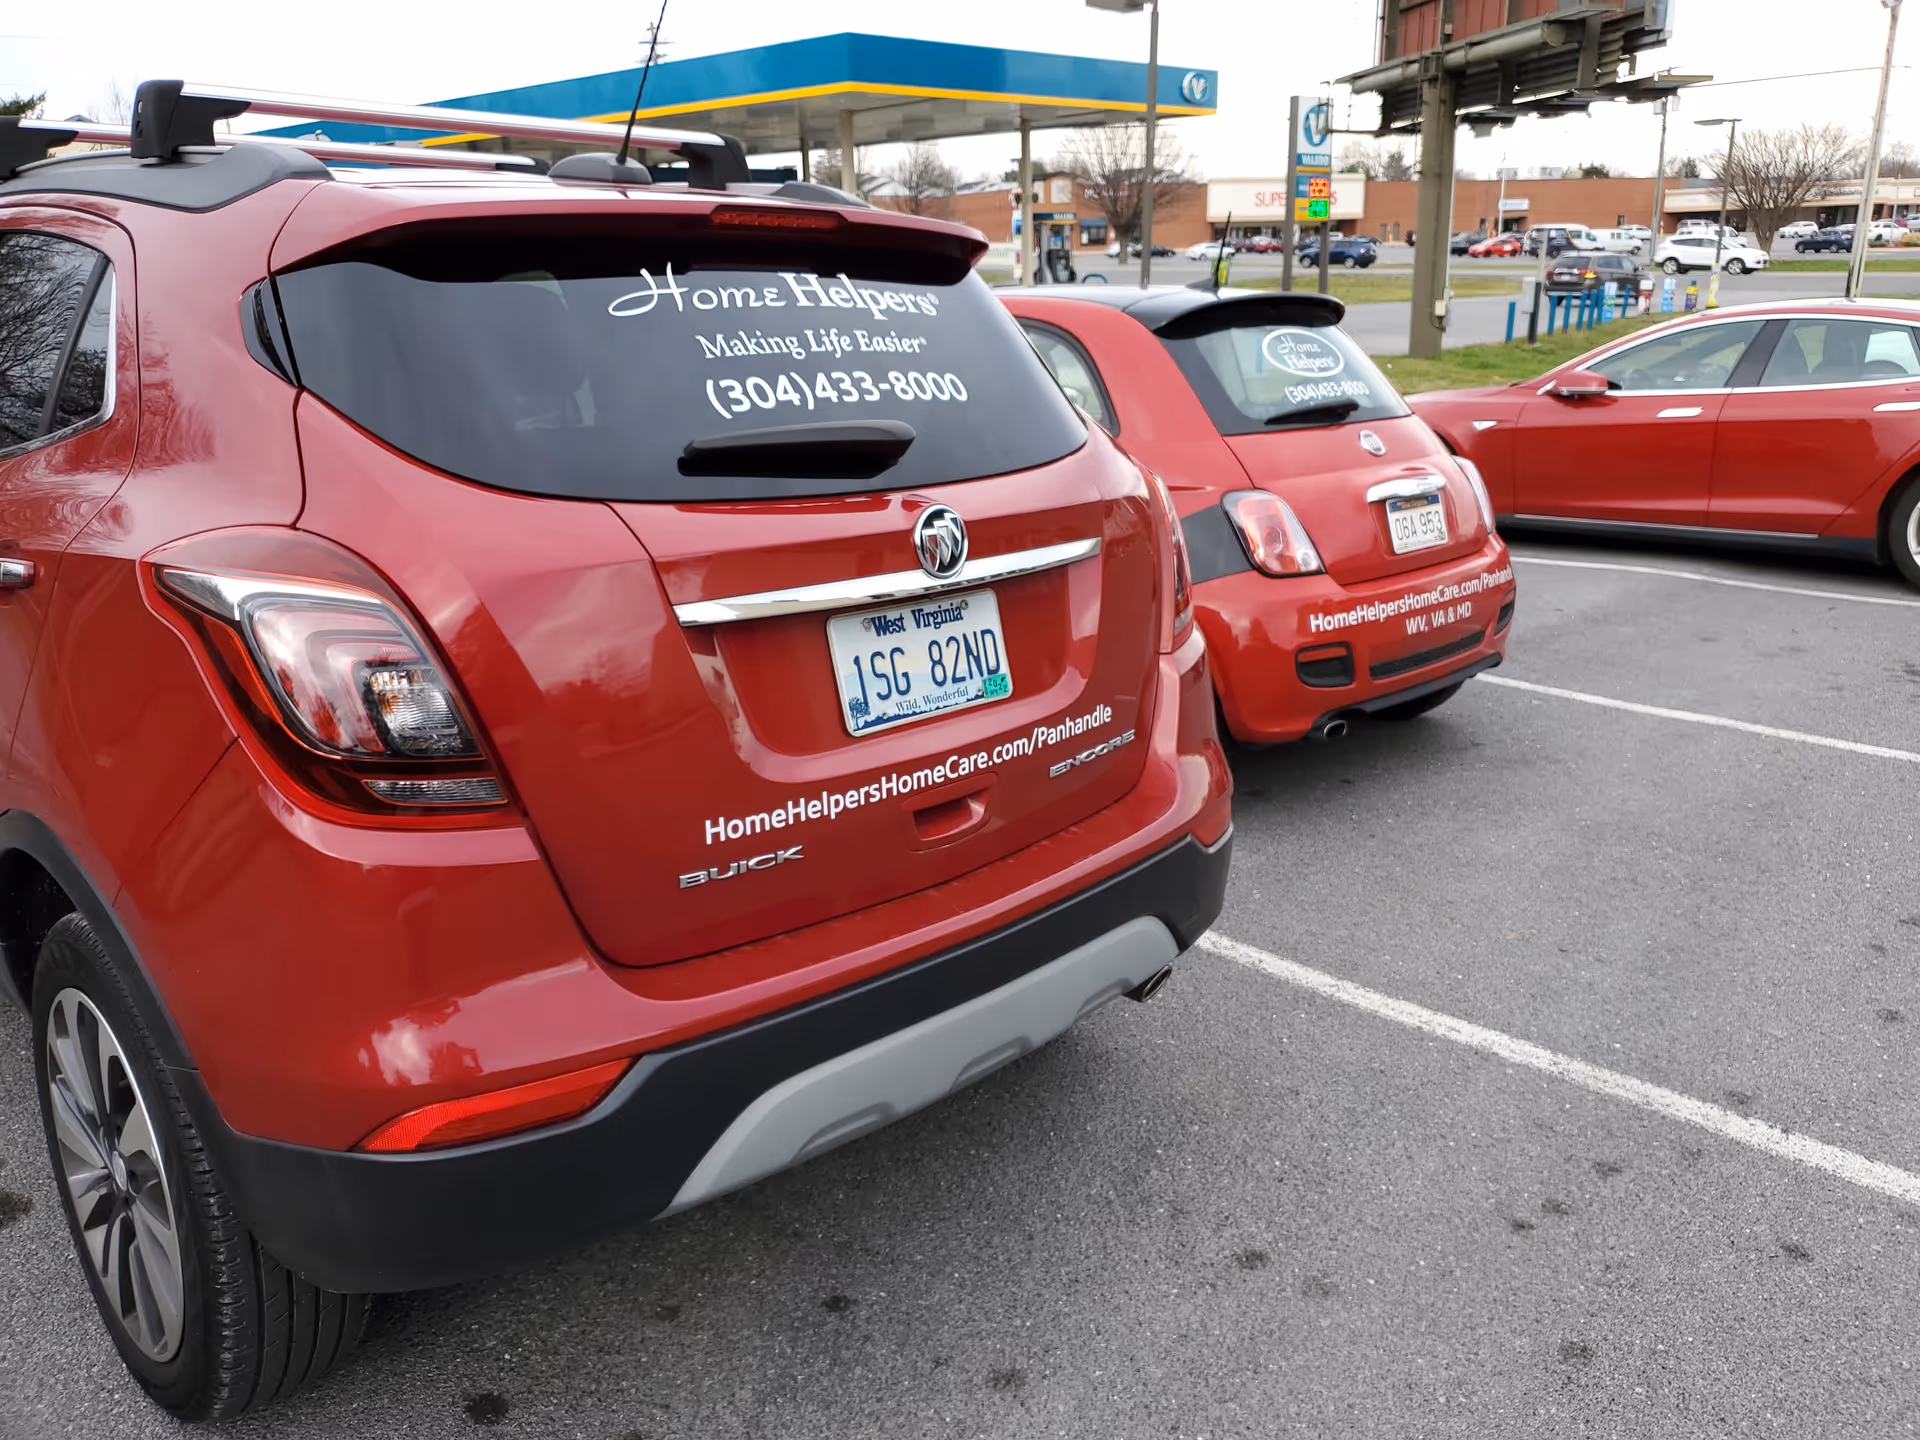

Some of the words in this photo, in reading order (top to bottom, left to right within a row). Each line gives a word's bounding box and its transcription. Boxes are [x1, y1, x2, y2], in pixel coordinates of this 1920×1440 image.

[608, 261, 787, 317] Home
[695, 331, 806, 359] Making
[804, 329, 853, 358] Life
[1277, 335, 1321, 353] Home
[705, 371, 968, 420] (304)433-8000
[1285, 381, 1370, 404] (304)433-8000
[1419, 510, 1442, 535] 953
[870, 614, 906, 637] West
[910, 601, 963, 630] Virginia
[1406, 616, 1428, 635] WV,
[1431, 609, 1446, 628] VA
[1447, 608, 1456, 623] &
[1456, 601, 1472, 620] MD
[853, 647, 911, 701] 1SG
[928, 628, 1000, 687] 82ND
[896, 699, 921, 713] Wild,
[922, 686, 969, 706] Wonderful
[1049, 729, 1136, 778] ENCORE
[705, 704, 1112, 845] HomeHelpersHomeCare.com/Panhandle
[678, 845, 805, 888] BUICK
